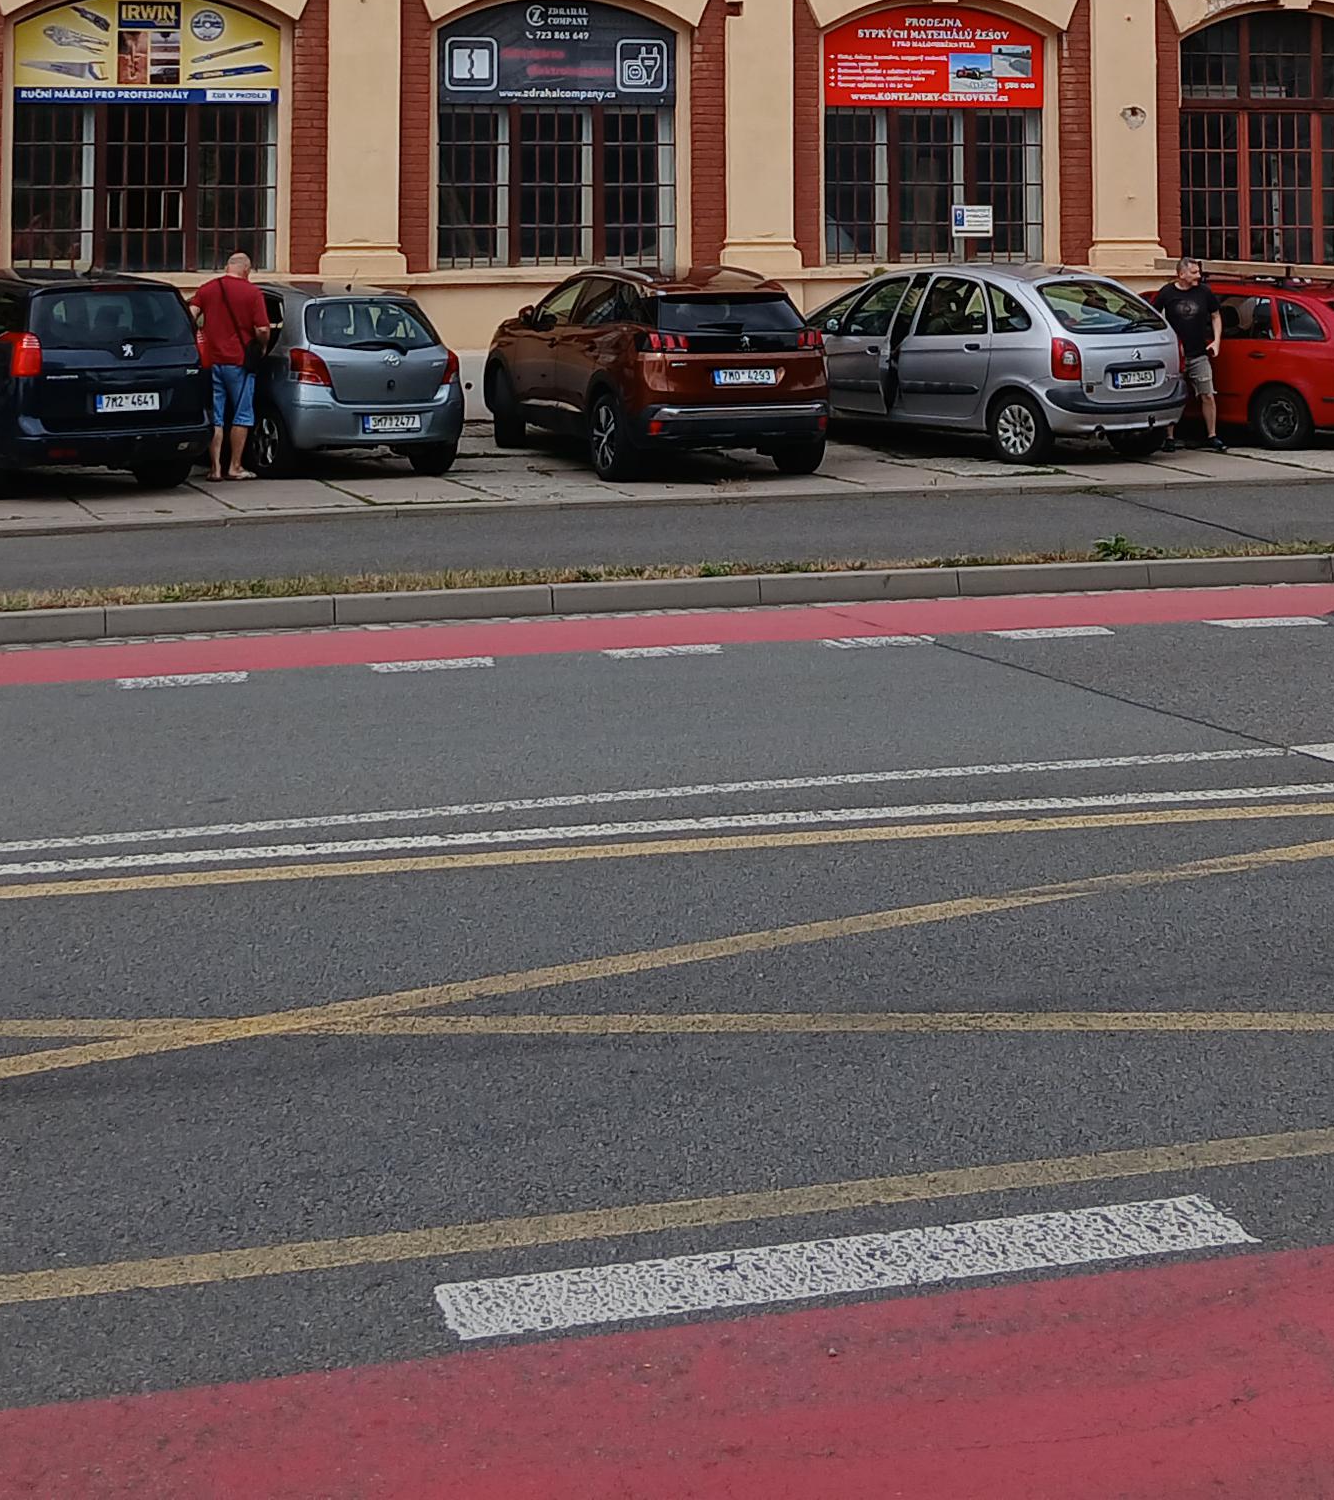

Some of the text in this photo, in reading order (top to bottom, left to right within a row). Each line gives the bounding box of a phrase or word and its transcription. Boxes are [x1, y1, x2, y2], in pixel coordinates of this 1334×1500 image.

[121, 4, 176, 21] IRWIN
[548, 17, 589, 26] COMPANY
[905, 17, 963, 28] PRODEJNA
[857, 27, 908, 39] SYPKÝCH
[20, 88, 190, 100] RUČNÍ NÁŘADÍ PRO PROFESIONÁLY
